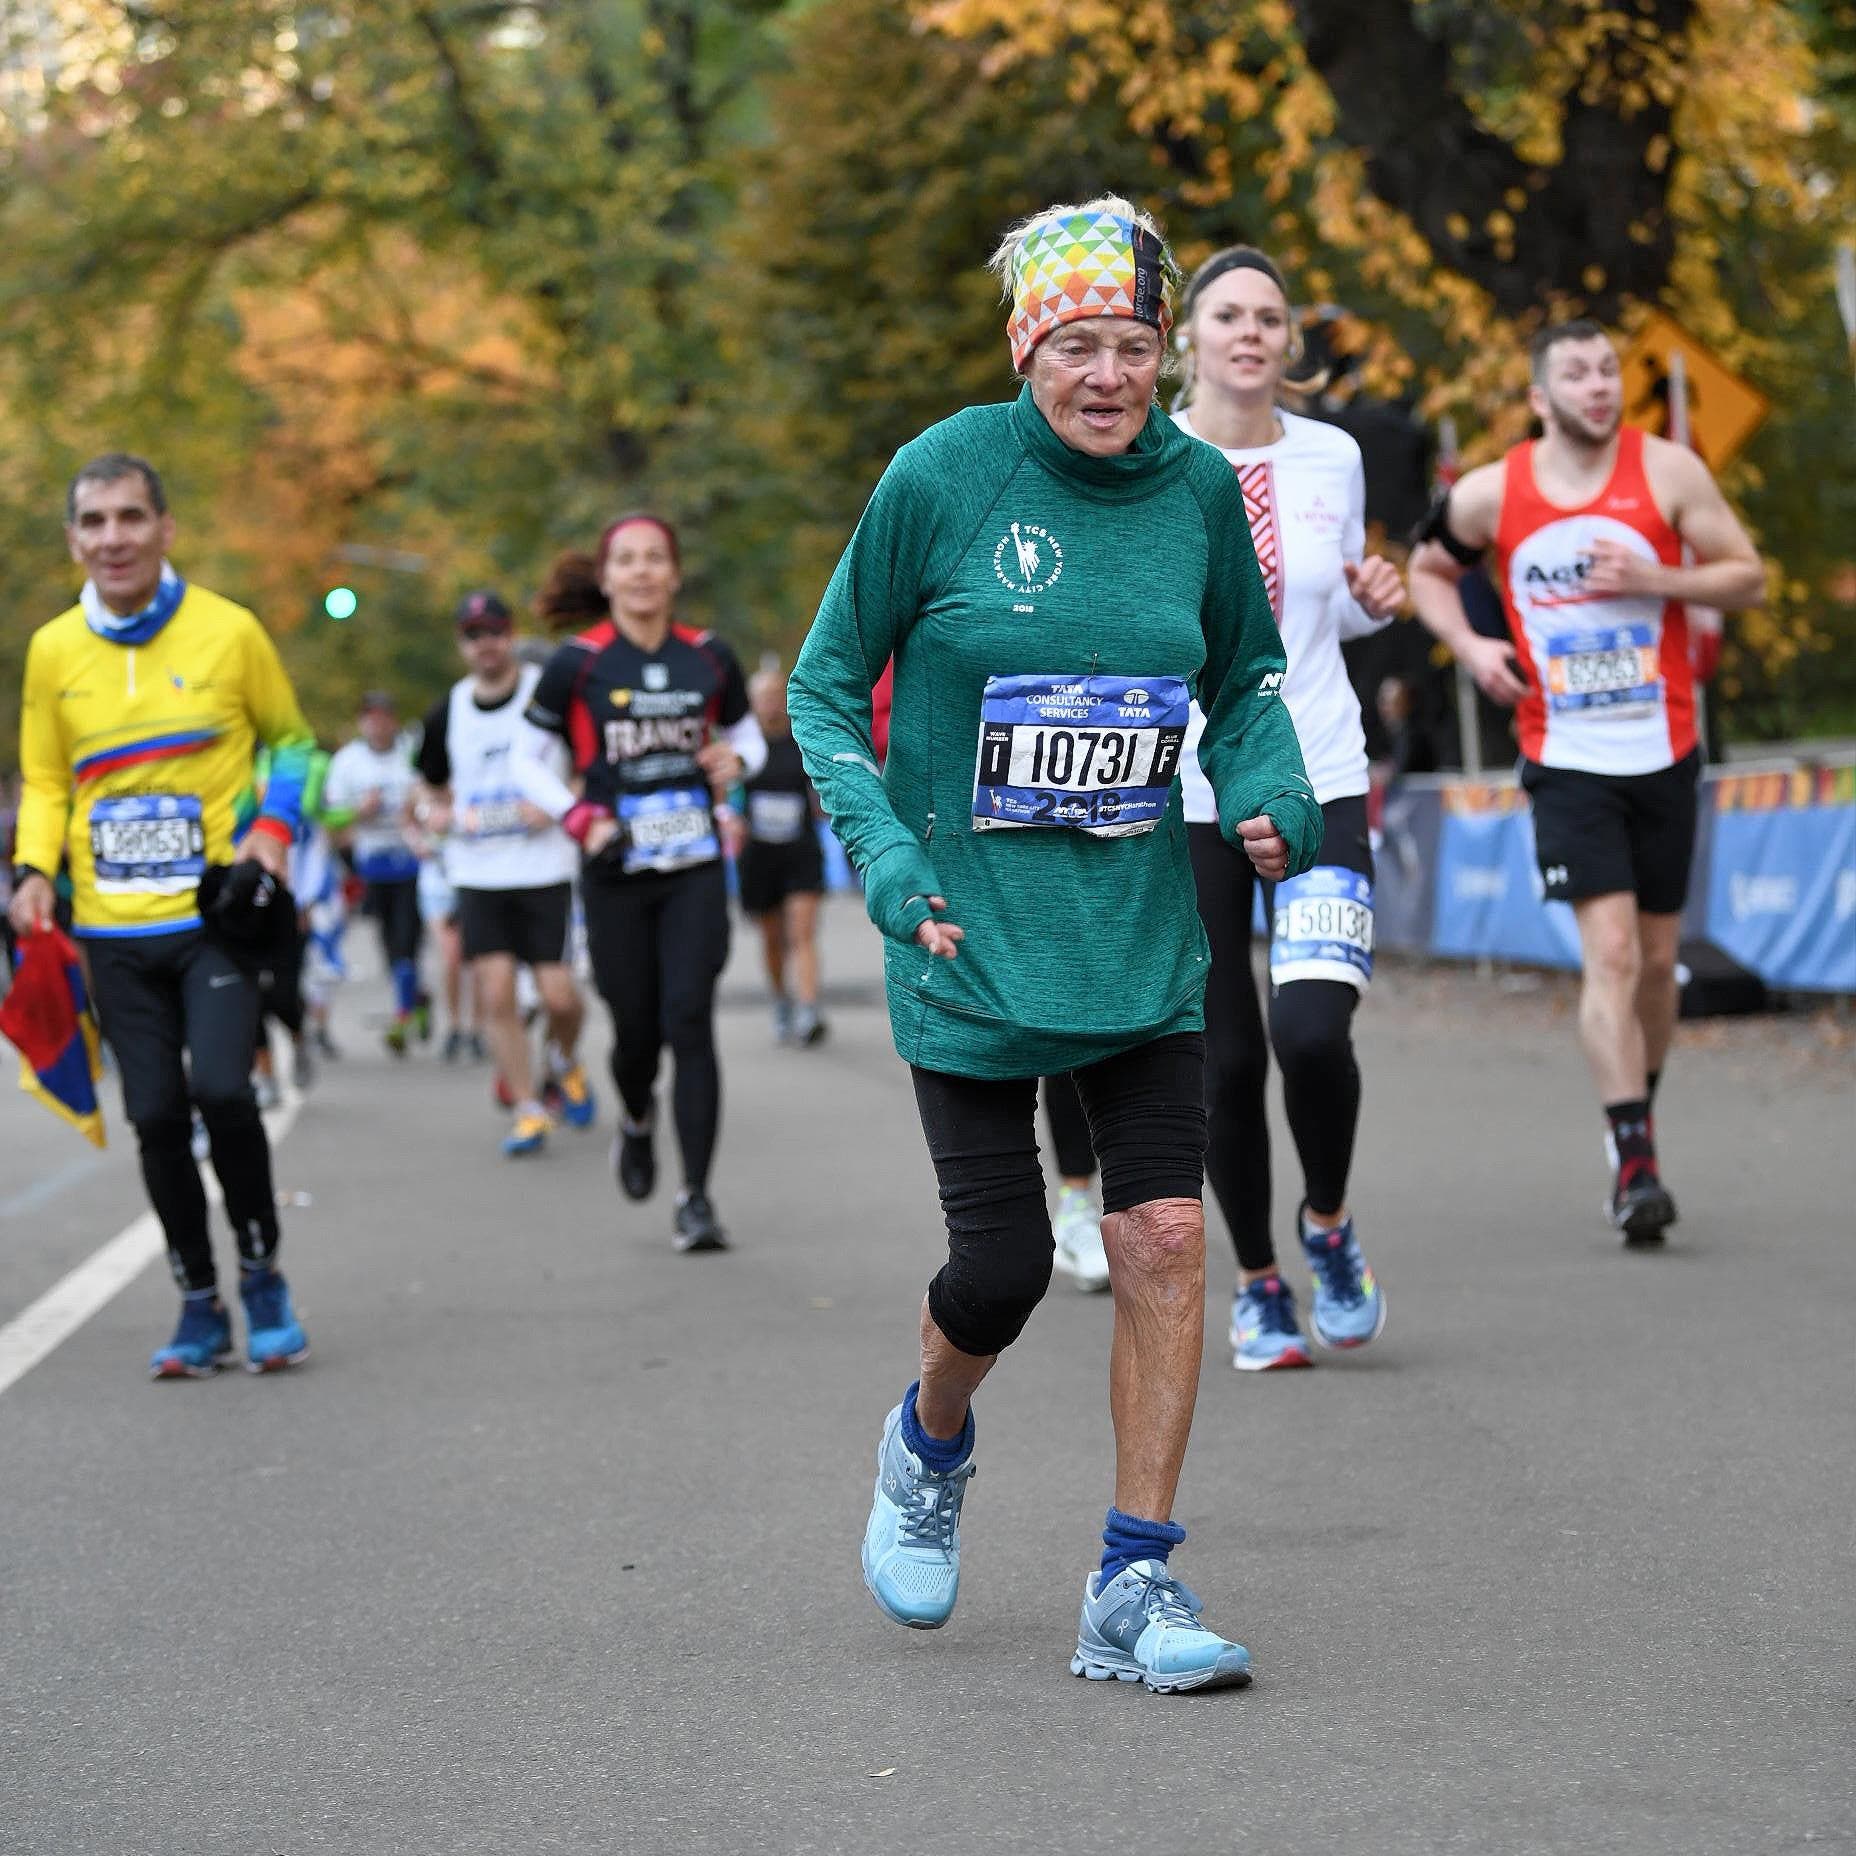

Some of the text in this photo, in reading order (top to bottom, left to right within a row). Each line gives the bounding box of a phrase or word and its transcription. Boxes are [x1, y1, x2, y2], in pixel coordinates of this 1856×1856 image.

[993, 525, 1064, 594] TCS NEW YORK CITY MARATHON
[1012, 604, 1035, 614] 2018
[1051, 684, 1084, 694] TATA
[1026, 694, 1105, 707] CONSULTANCY
[1039, 707, 1090, 719] SERVICES
[1117, 706, 1151, 718] TATA
[1031, 730, 1138, 786] 10731
[1157, 745, 1175, 773] F
